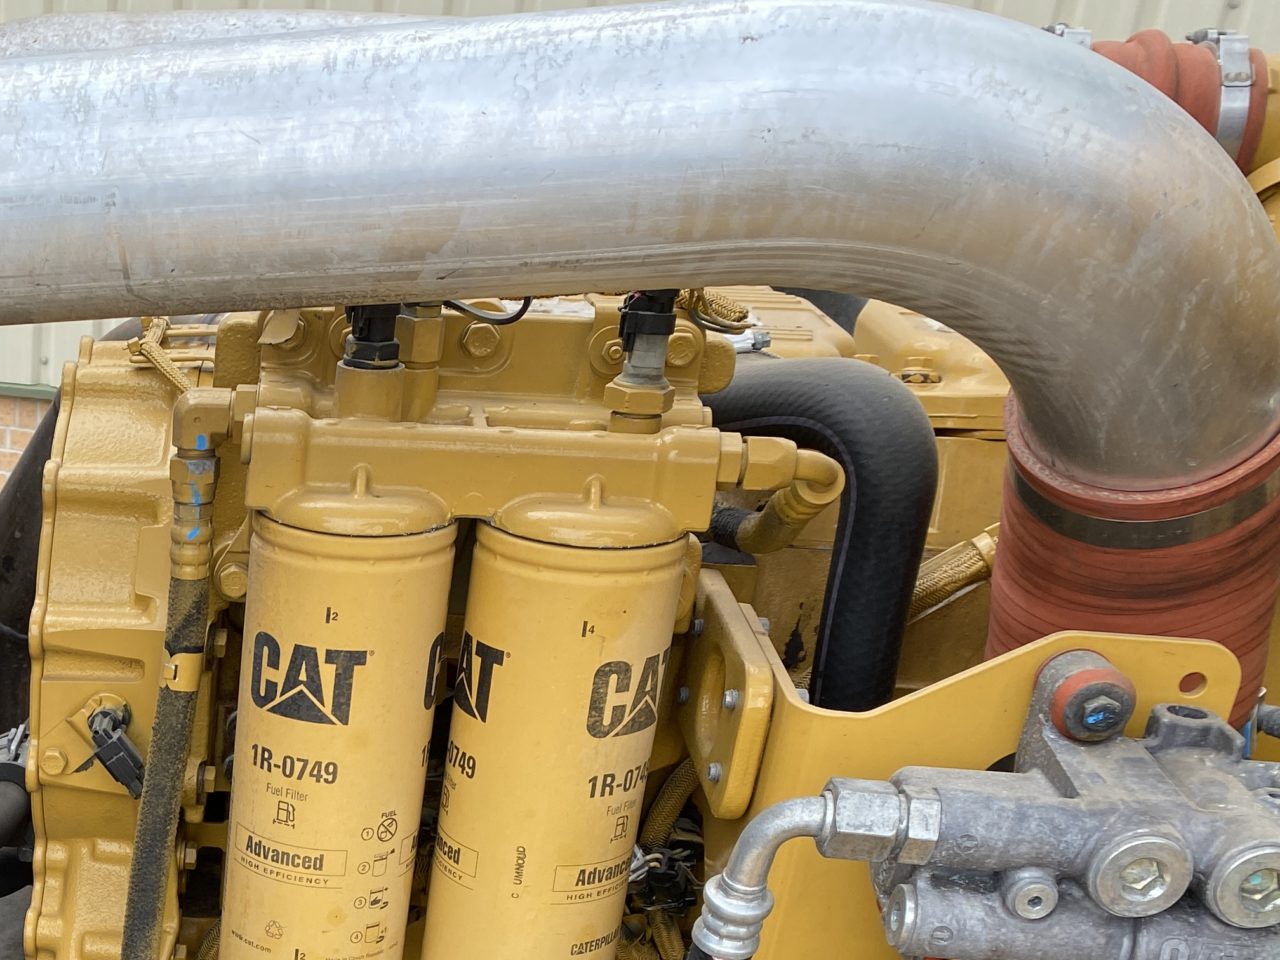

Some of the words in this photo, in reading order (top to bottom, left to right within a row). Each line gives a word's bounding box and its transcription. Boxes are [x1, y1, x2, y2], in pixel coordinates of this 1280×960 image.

[251, 631, 367, 725] CAT
[454, 630, 505, 723] AT
[251, 743, 338, 784] 1R-0749
[266, 783, 283, 797] Fuel
[285, 787, 308, 801] Filter
[240, 855, 260, 870] HIGH
[263, 866, 329, 885] EFFICIENCY
[246, 834, 324, 871] Advanced
[567, 892, 593, 901] HIGH
